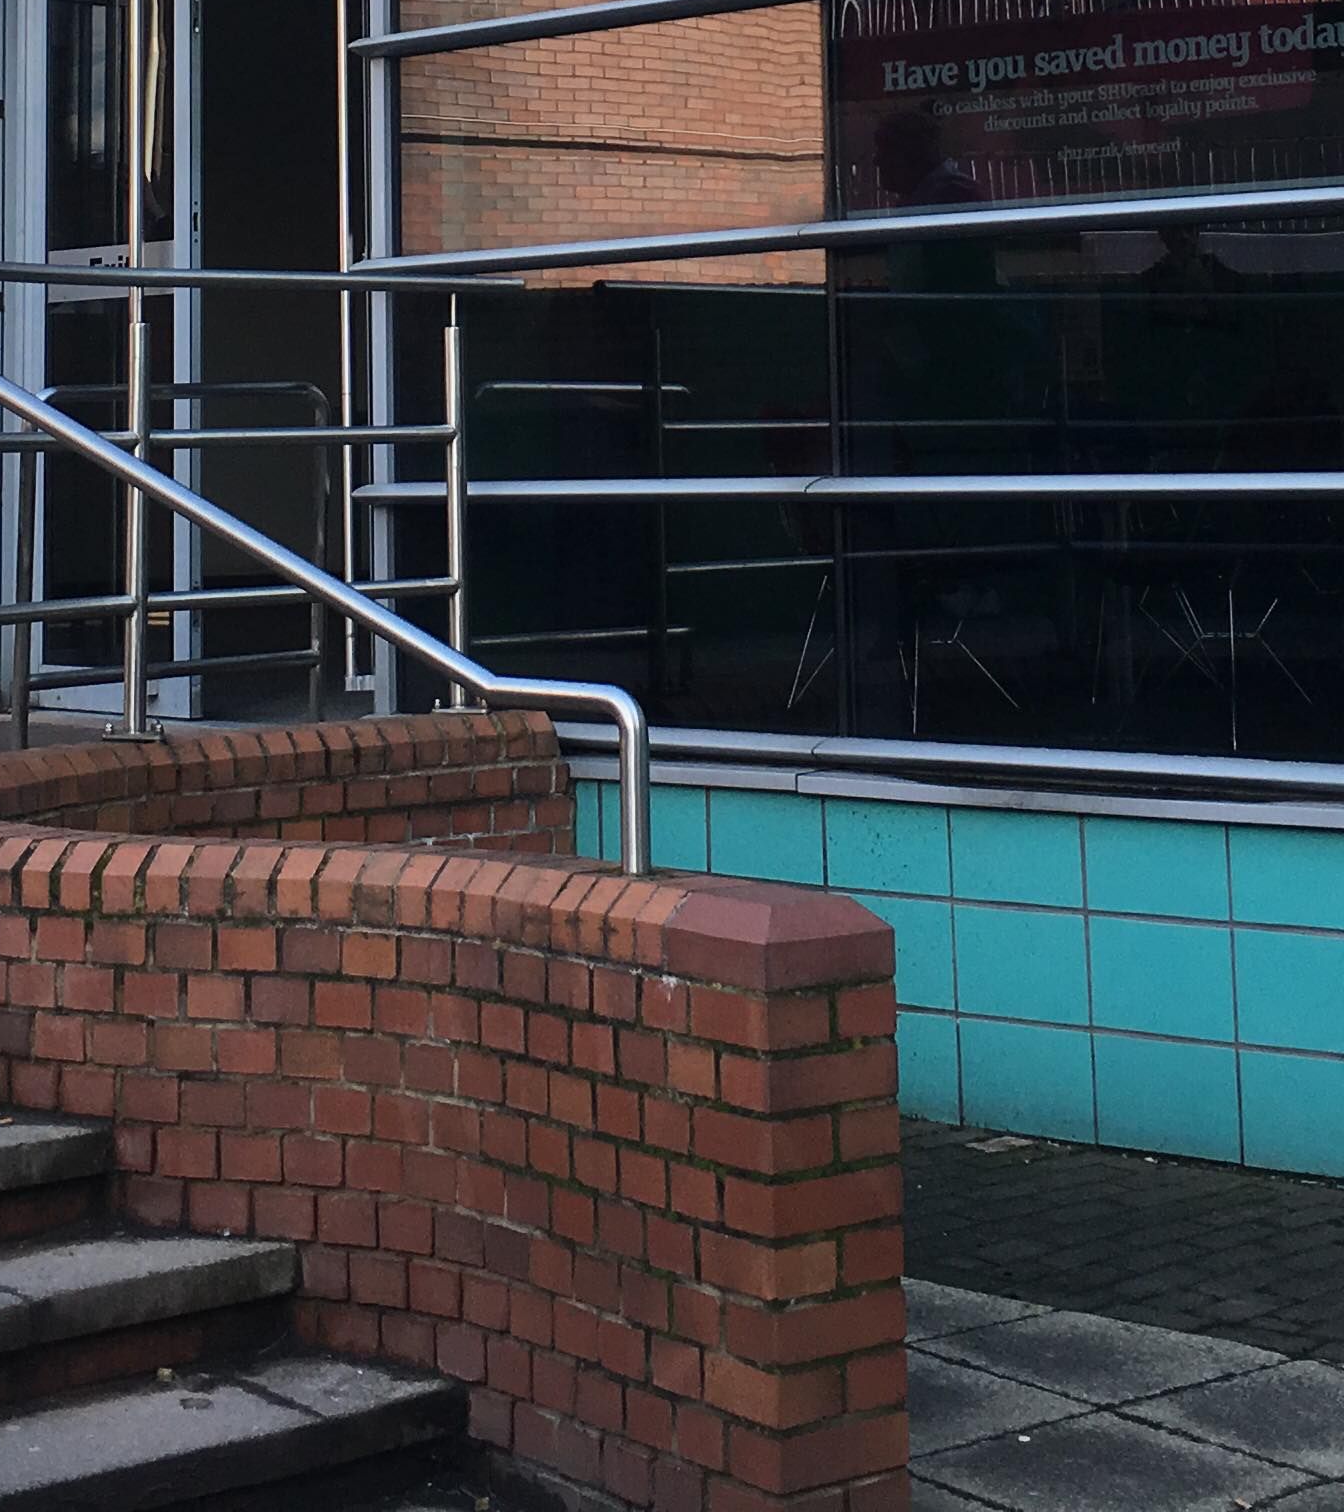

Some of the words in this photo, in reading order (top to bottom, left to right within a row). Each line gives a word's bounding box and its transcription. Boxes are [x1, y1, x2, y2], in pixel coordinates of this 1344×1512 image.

[882, 60, 960, 93] Have
[966, 53, 1027, 93] you
[1034, 33, 1126, 77] saved
[1133, 30, 1252, 68] money
[932, 99, 953, 116] Go
[956, 92, 1017, 114] cashless
[1020, 89, 1056, 108] with
[1057, 88, 1094, 111] your
[1097, 79, 1167, 101] SHUcard
[1170, 79, 1187, 94] to
[1189, 72, 1235, 93] enjoy
[1238, 66, 1318, 89] exclusive
[983, 112, 1057, 133] discounts
[1058, 109, 1088, 126] and
[1090, 102, 1142, 122] collect
[1145, 97, 1202, 123] loyalty
[1205, 93, 1260, 120] points.
